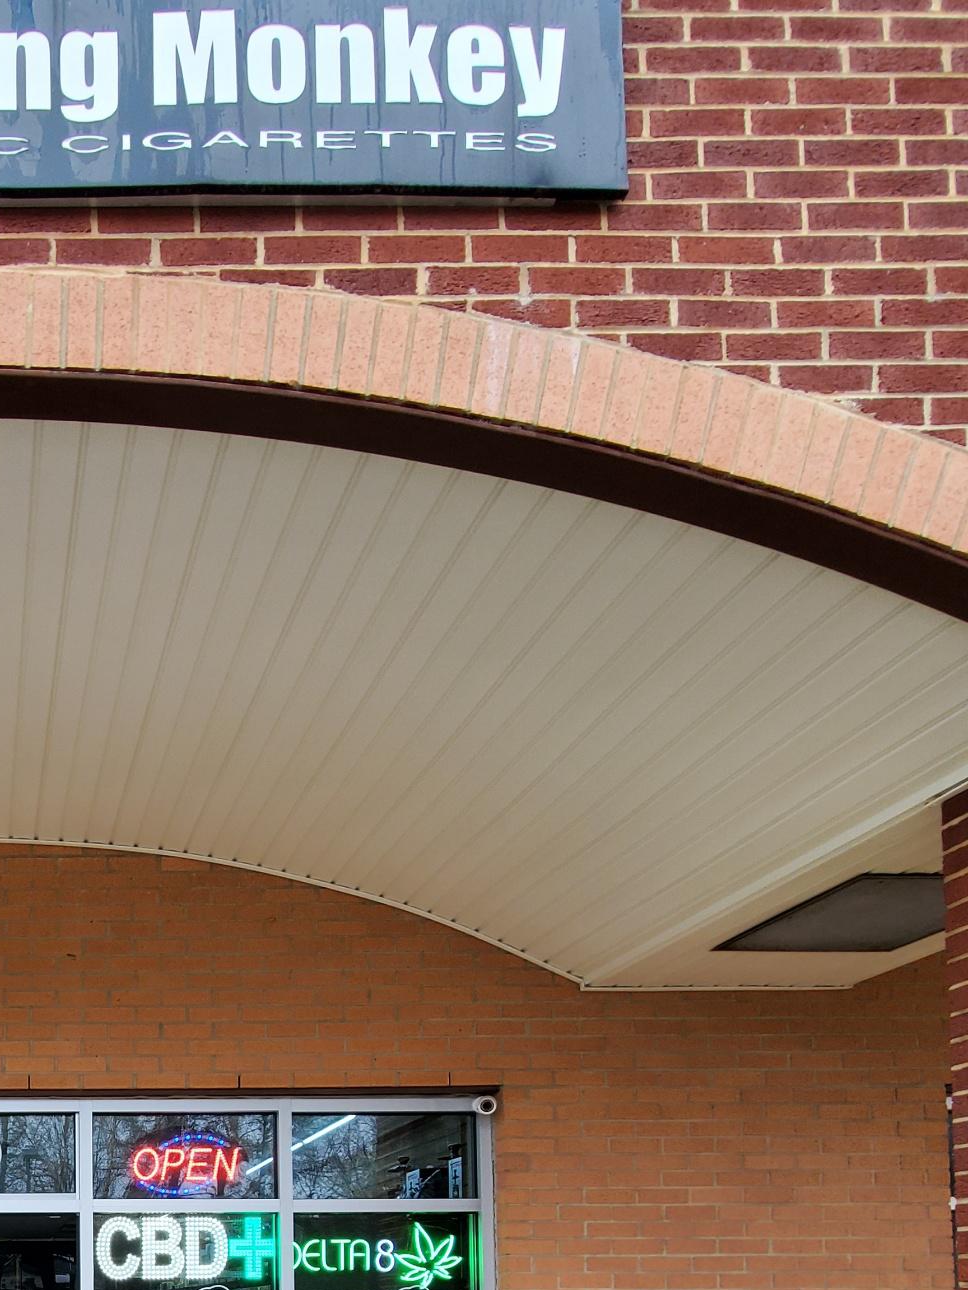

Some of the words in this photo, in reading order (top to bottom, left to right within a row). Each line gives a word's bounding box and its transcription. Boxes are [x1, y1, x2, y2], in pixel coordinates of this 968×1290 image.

[152, 6, 566, 118] Monkey
[61, 129, 558, 154] CIGARETTES
[133, 1146, 242, 1182] OPEN
[375, 1238, 395, 1273] 8
